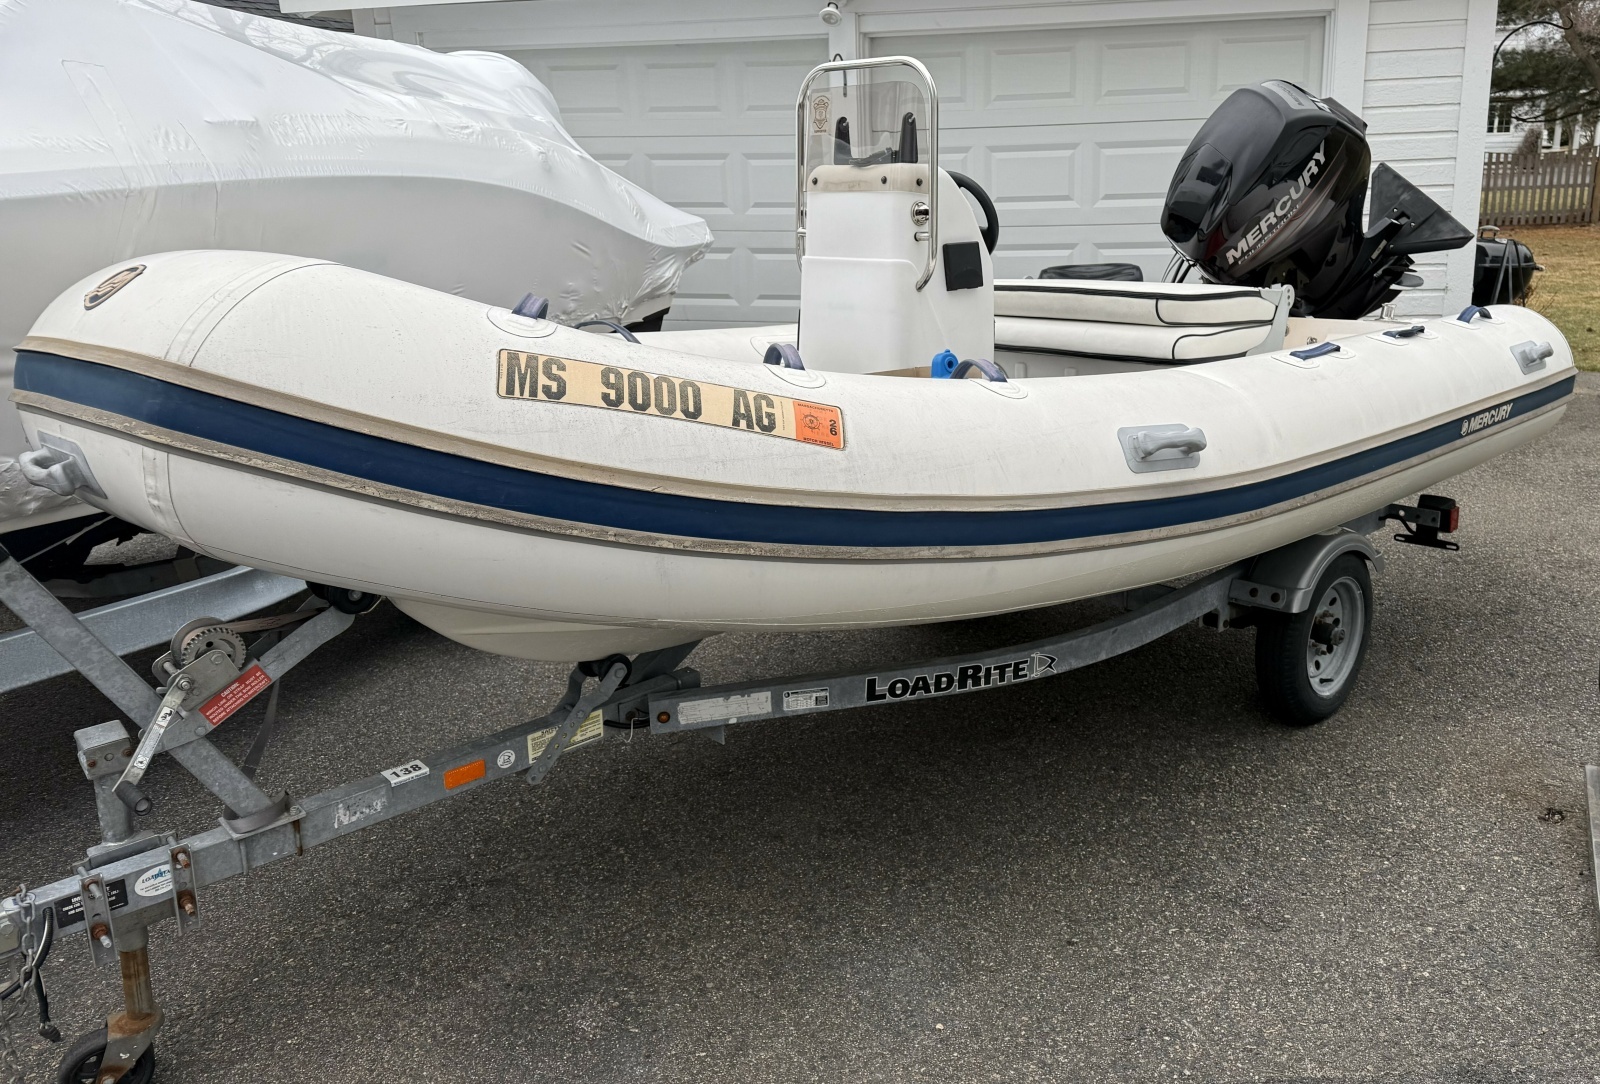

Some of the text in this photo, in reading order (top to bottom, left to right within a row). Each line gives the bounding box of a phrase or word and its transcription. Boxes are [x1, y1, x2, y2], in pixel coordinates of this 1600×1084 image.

[1226, 140, 1325, 265] MERCURY
[506, 352, 566, 400] MS
[601, 367, 702, 420] 9000
[732, 390, 776, 433] AG
[797, 403, 834, 413] MASSACHUSETTS
[1468, 403, 1513, 433] MERCURY
[390, 764, 422, 778] 138
